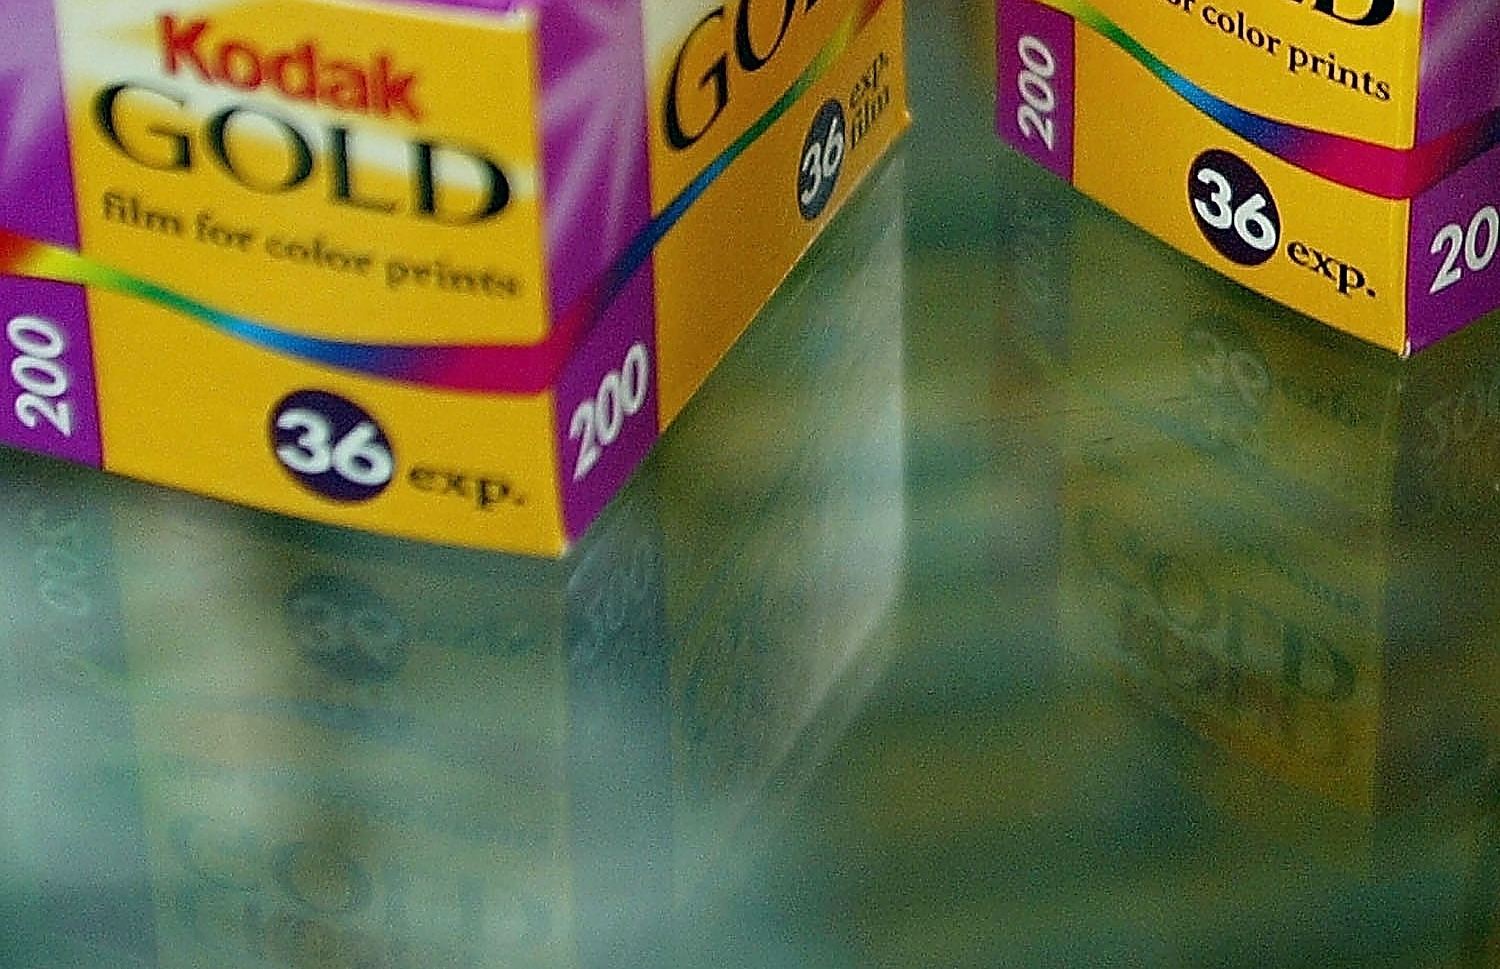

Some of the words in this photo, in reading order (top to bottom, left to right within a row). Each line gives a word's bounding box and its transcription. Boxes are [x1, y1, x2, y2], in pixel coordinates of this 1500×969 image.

[156, 12, 423, 124] Kodak
[1016, 34, 1058, 152] 200
[1201, 10, 1282, 56] color
[1286, 42, 1391, 103] prints
[92, 77, 513, 228] GOLD
[799, 113, 846, 207] 36
[101, 191, 185, 237] film
[194, 205, 255, 254] for
[264, 235, 373, 277] color
[384, 256, 523, 297] prints
[1193, 167, 1278, 251] 36
[1286, 237, 1378, 299] exp.
[4, 313, 76, 441] 200
[567, 339, 652, 483] 200
[274, 406, 396, 488] 36
[408, 462, 528, 511] exp.
